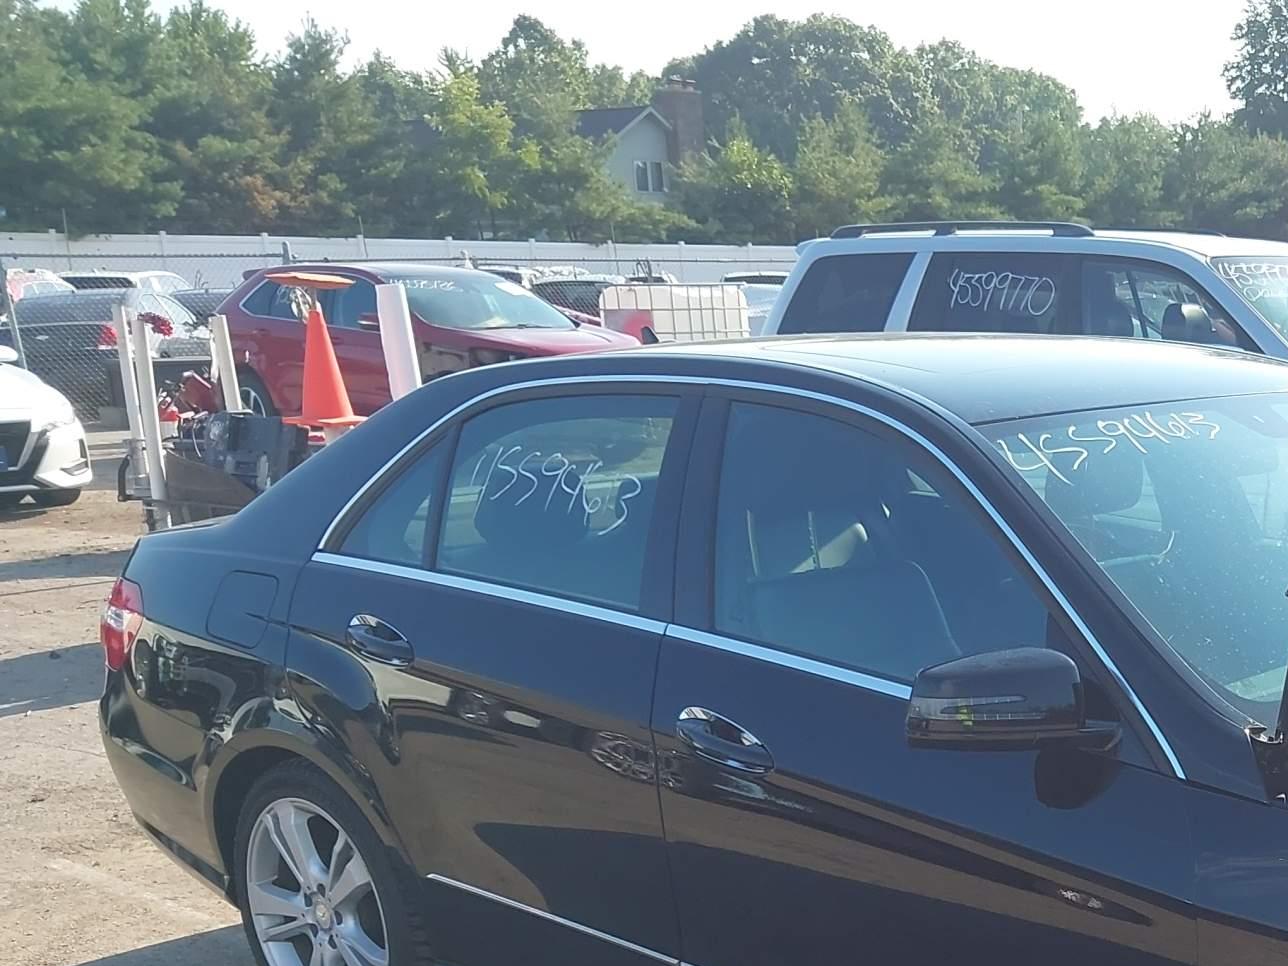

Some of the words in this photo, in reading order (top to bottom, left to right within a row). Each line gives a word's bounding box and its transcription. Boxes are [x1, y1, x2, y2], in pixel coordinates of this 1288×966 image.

[949, 267, 1056, 316] 45599770
[996, 410, 1222, 487] 45594613
[470, 445, 642, 536] 45594613
